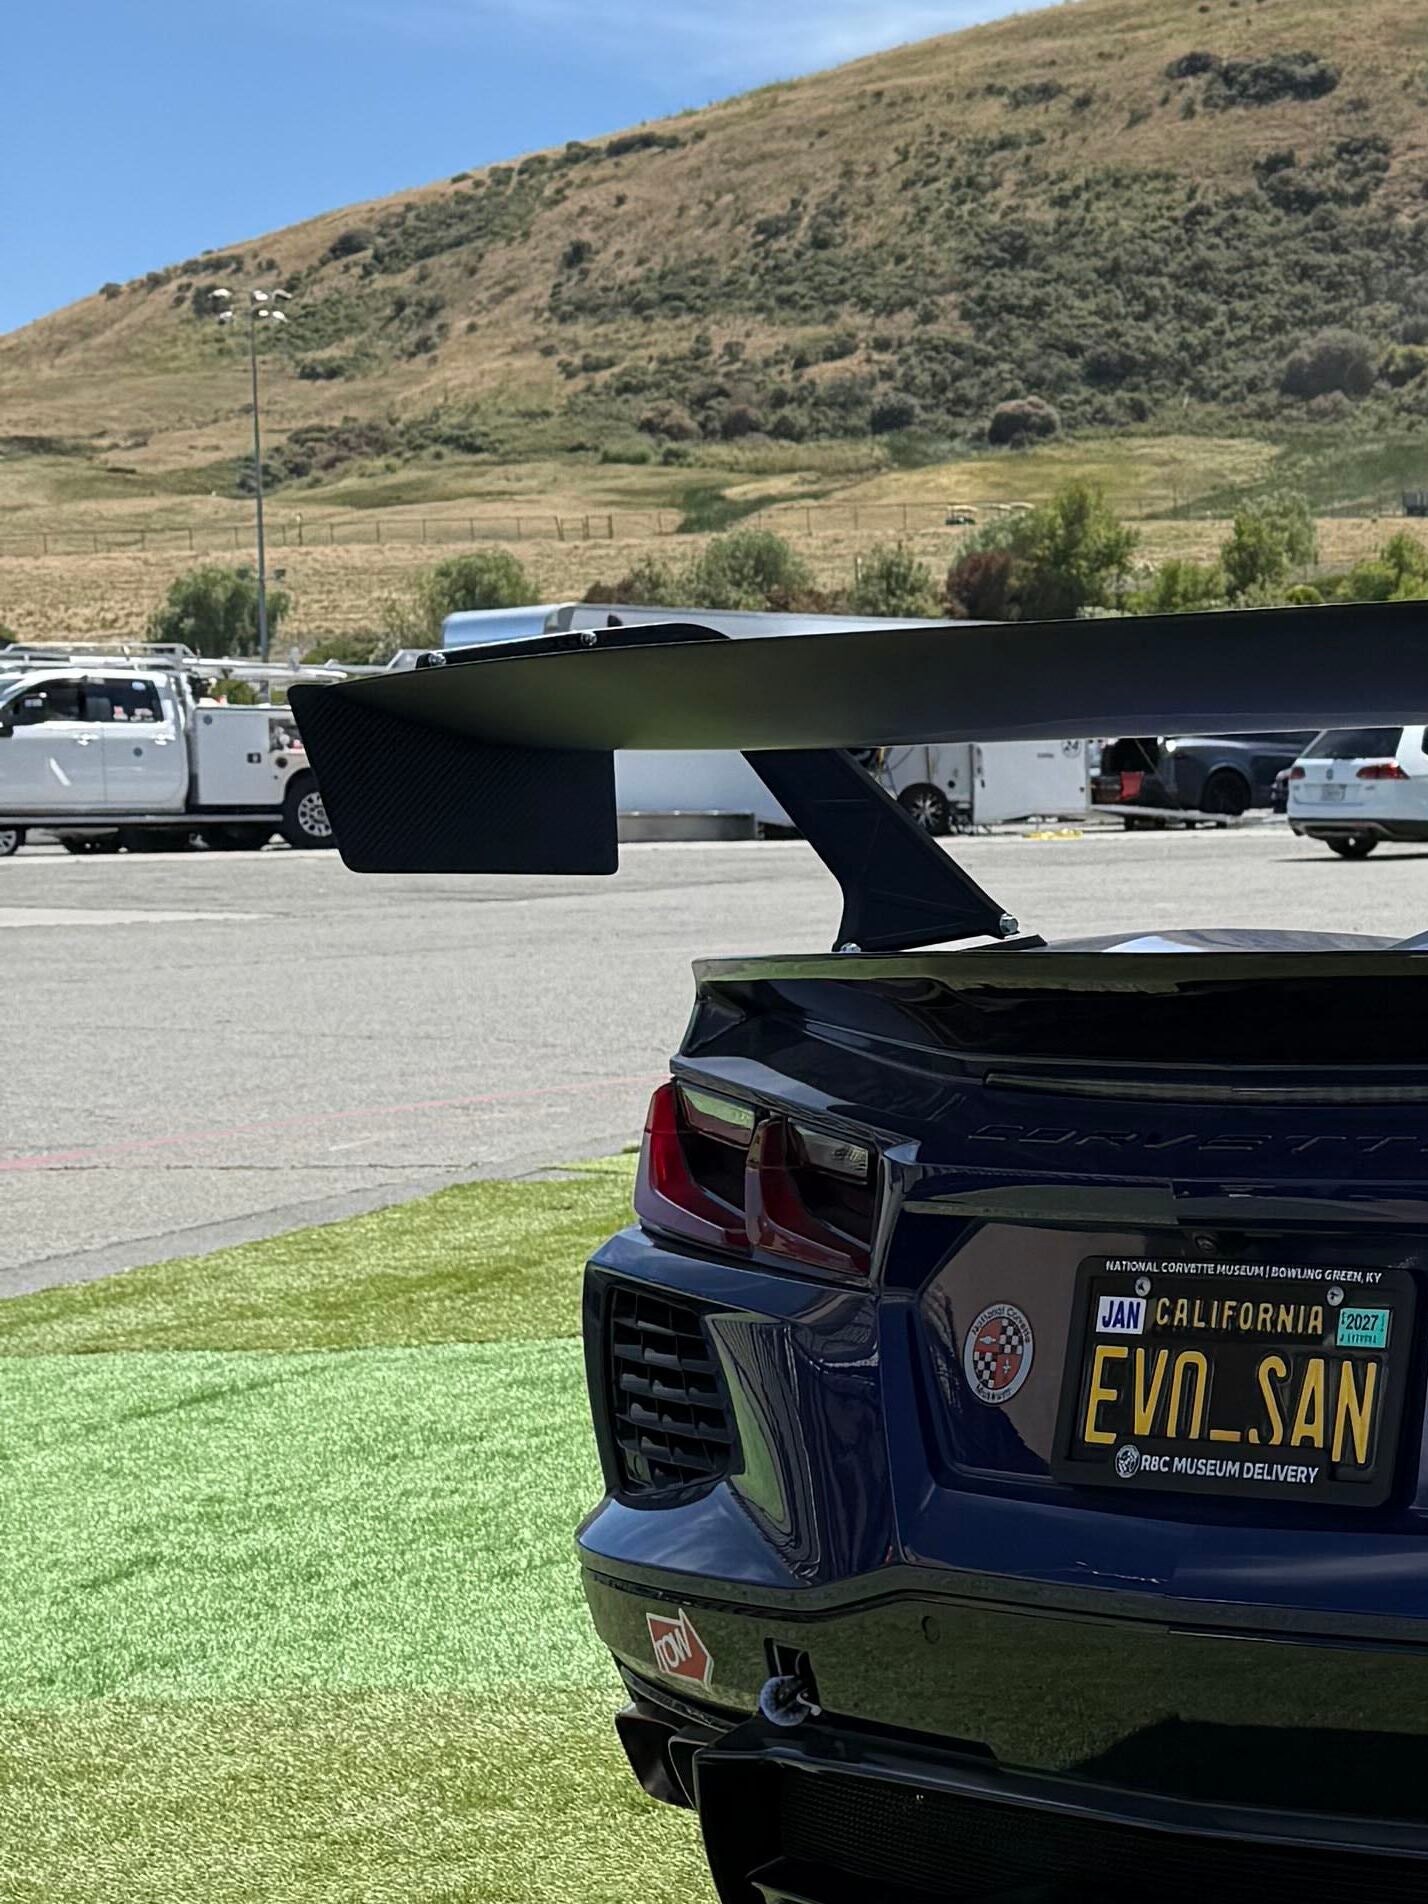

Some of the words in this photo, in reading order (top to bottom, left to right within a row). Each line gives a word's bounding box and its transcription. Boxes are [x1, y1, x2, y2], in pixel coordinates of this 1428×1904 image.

[1105, 1260, 1160, 1273] NATIONAL
[1161, 1262, 1215, 1275] CORVETTE
[1216, 1264, 1265, 1278] MUSEUM
[1271, 1266, 1322, 1280] BOWLING
[1324, 1269, 1365, 1284] GREEN,
[1366, 1272, 1382, 1284] KY
[1102, 1300, 1141, 1330] JAN
[1155, 1297, 1323, 1333] CALIFORNIA
[1346, 1314, 1379, 1331] 2027
[1172, 1458, 1240, 1478] MUSEUM
[1242, 1462, 1319, 1484] DELIVERY
[656, 1628, 692, 1673] TOW
